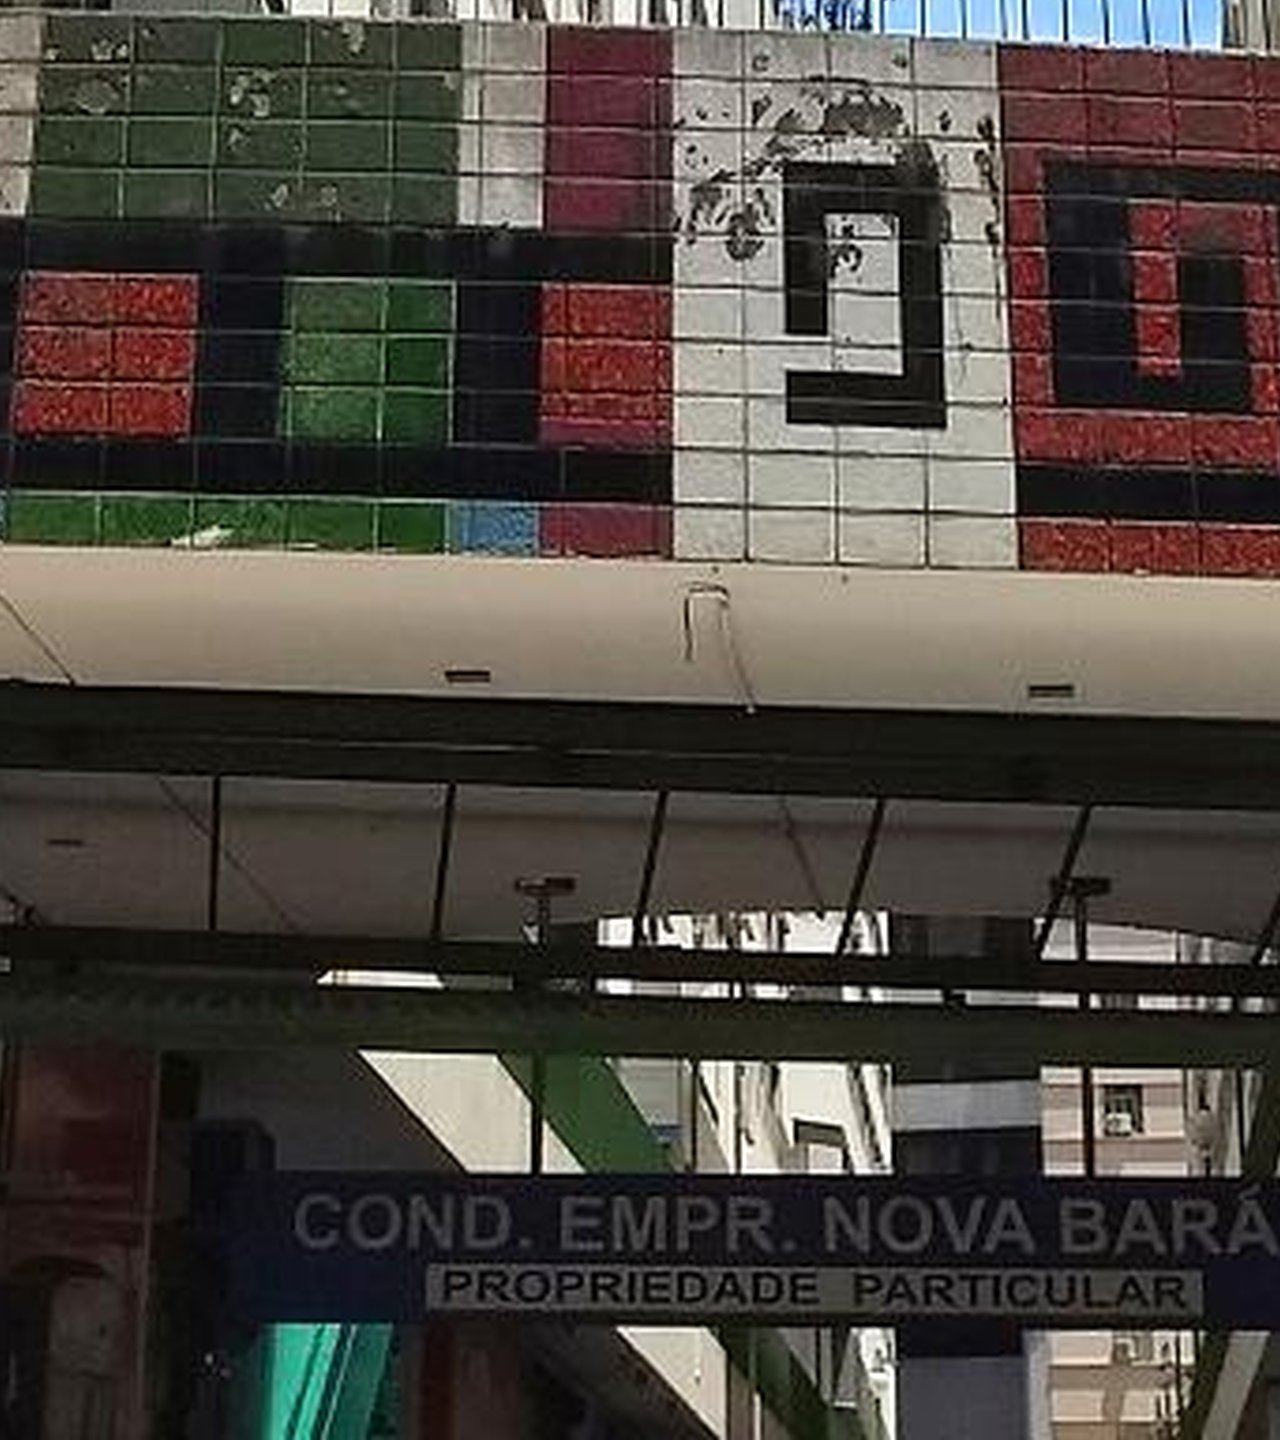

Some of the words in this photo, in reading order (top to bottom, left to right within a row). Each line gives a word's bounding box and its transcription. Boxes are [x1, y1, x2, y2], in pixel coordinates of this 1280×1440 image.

[293, 1193, 532, 1251] COND.
[559, 1194, 799, 1253] EMPR.
[822, 1195, 1037, 1255] NOVA
[442, 1270, 819, 1306] PROPRIEDADE
[852, 1274, 1188, 1309] PARTICULAR
